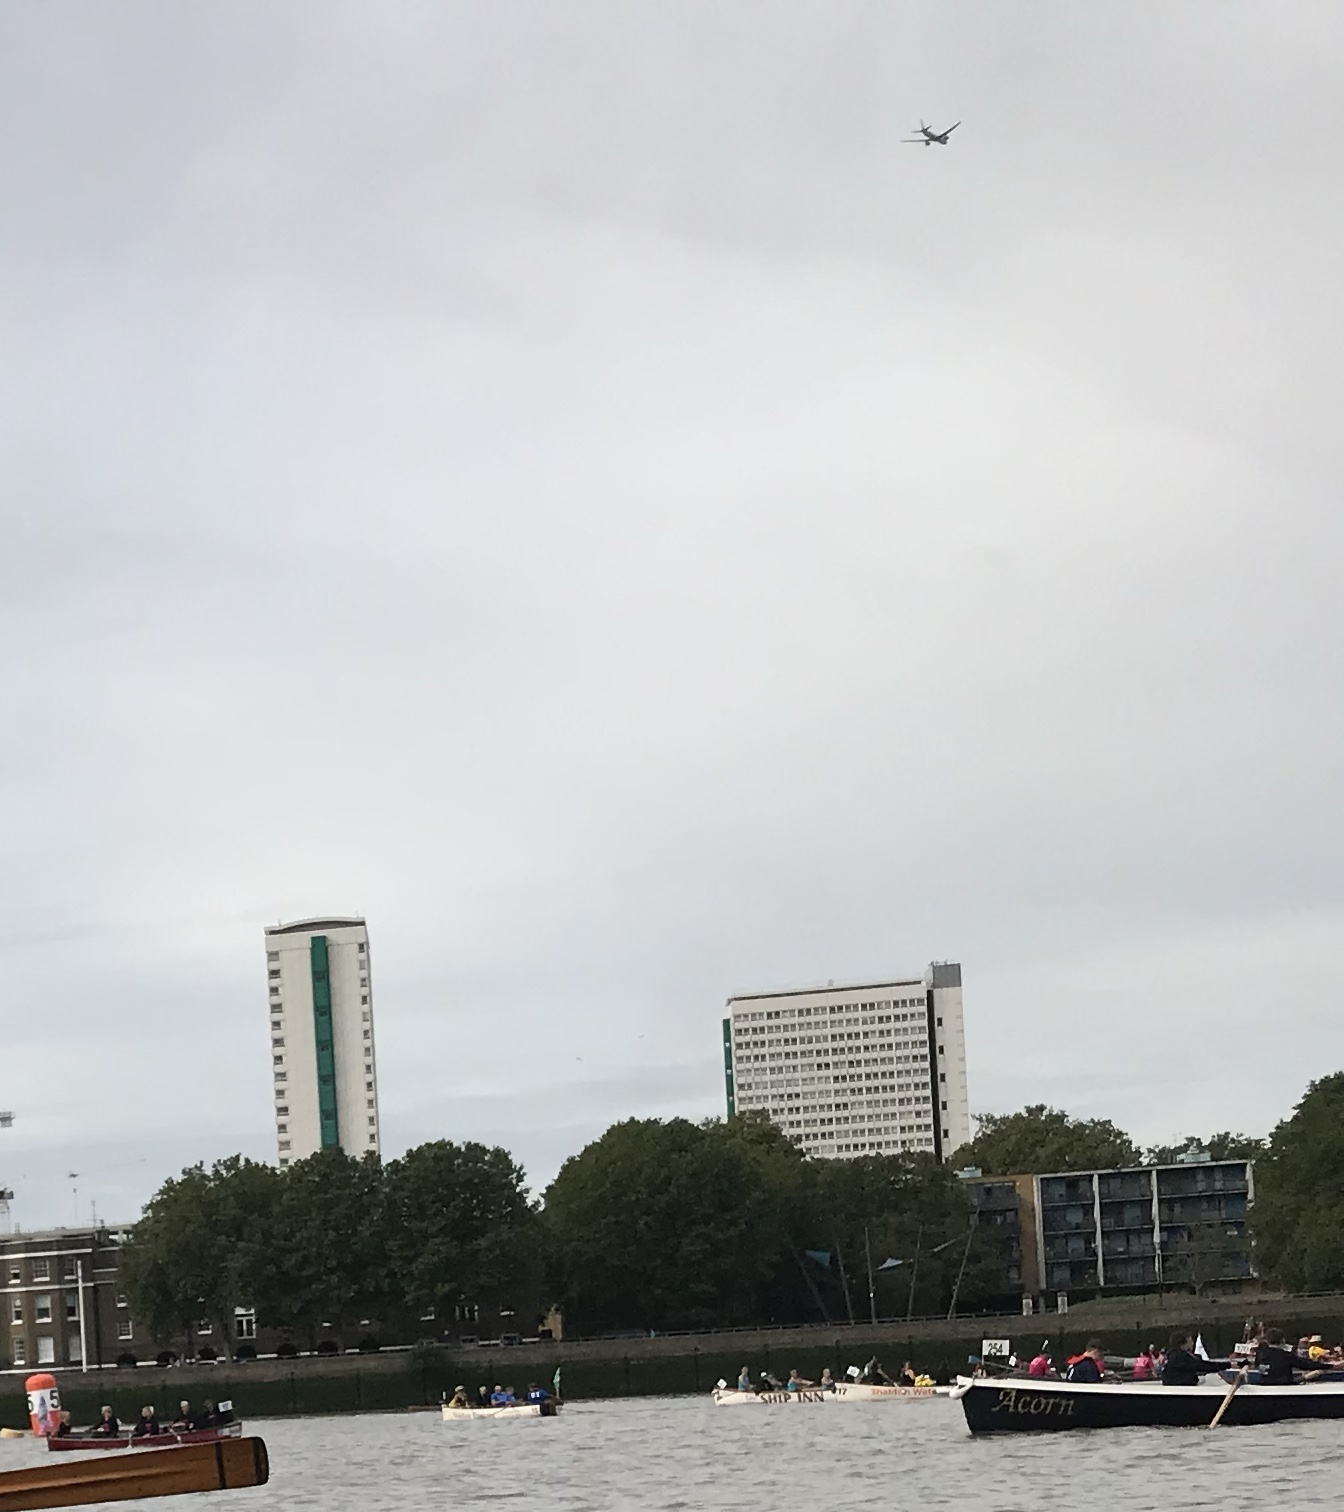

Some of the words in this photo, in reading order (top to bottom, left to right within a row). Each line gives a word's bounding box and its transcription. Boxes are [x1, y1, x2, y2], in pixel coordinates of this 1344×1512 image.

[50, 1389, 61, 1409] 5
[760, 1392, 792, 1404] SHIP
[798, 1391, 825, 1403] INN
[992, 1388, 1075, 1416] Acorn
